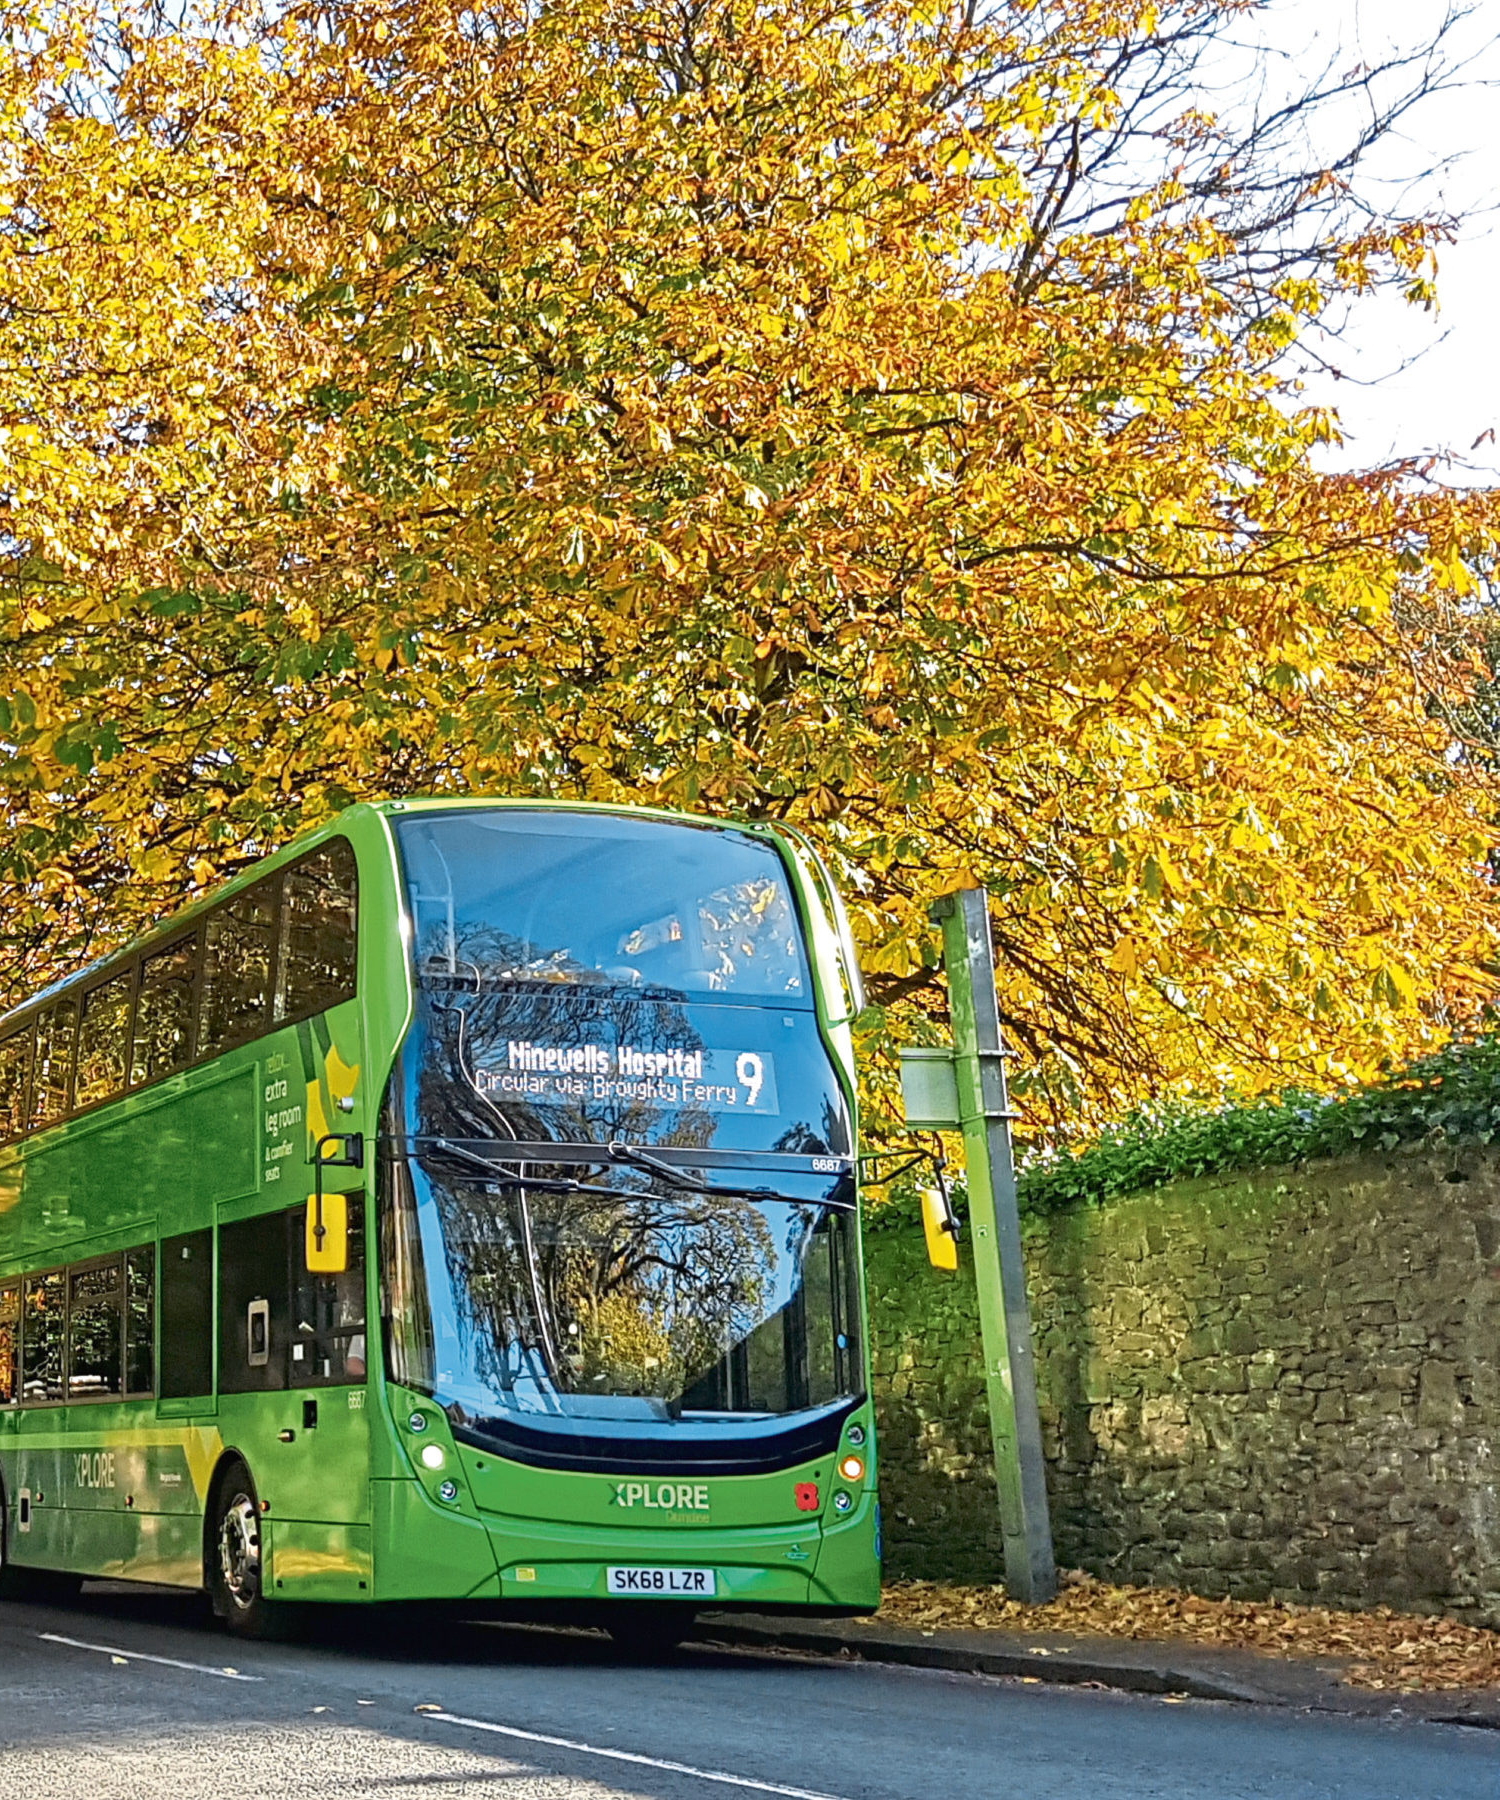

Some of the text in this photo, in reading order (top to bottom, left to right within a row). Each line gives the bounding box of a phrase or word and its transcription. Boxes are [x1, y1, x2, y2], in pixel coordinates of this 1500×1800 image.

[508, 1041, 702, 1078] Ninewells Hospital
[265, 1079, 287, 1102] extra
[475, 1069, 549, 1092] Circular
[593, 1075, 677, 1102] Broughty
[682, 1080, 737, 1105] Ferry
[736, 1052, 763, 1106] 9
[265, 1105, 301, 1137] leg room
[812, 1158, 841, 1171] 6687
[73, 1453, 115, 1488] XPLORE
[607, 1483, 710, 1510] XPLORE
[614, 1570, 705, 1591] SK68 LZR
